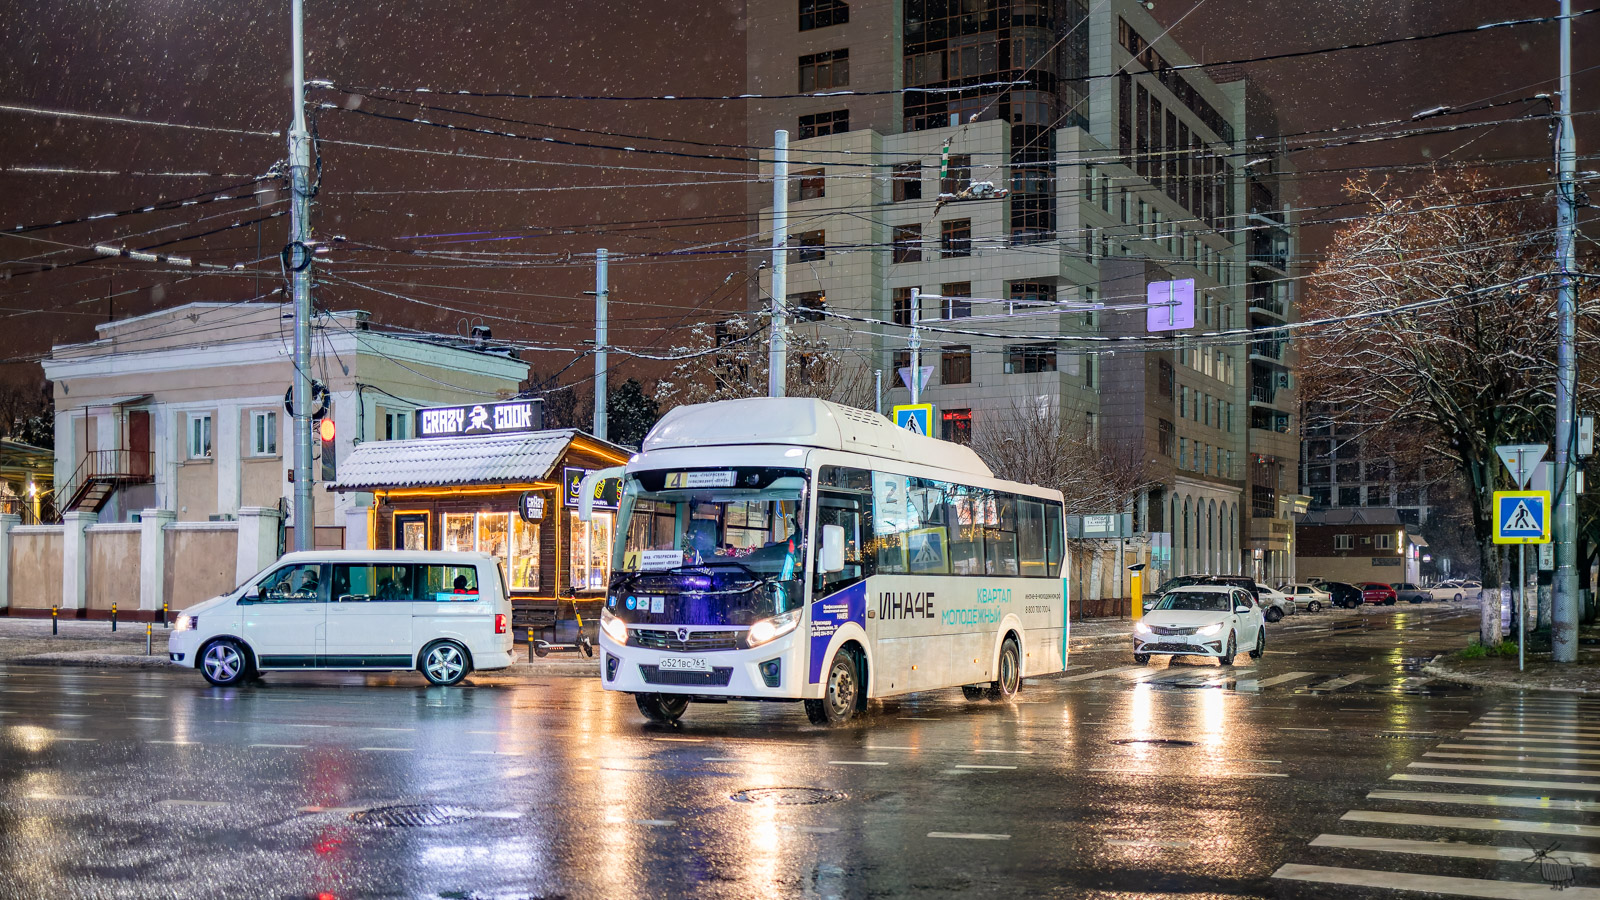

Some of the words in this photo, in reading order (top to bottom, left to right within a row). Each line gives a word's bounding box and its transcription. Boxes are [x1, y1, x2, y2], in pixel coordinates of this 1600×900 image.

[422, 408, 465, 434] CRAZY
[493, 404, 532, 430] COOK
[671, 472, 682, 488] 4
[526, 495, 544, 508] CRAZY
[528, 508, 543, 518] COOK
[628, 555, 638, 572] 4
[976, 588, 1012, 603] КВАРТАЛ
